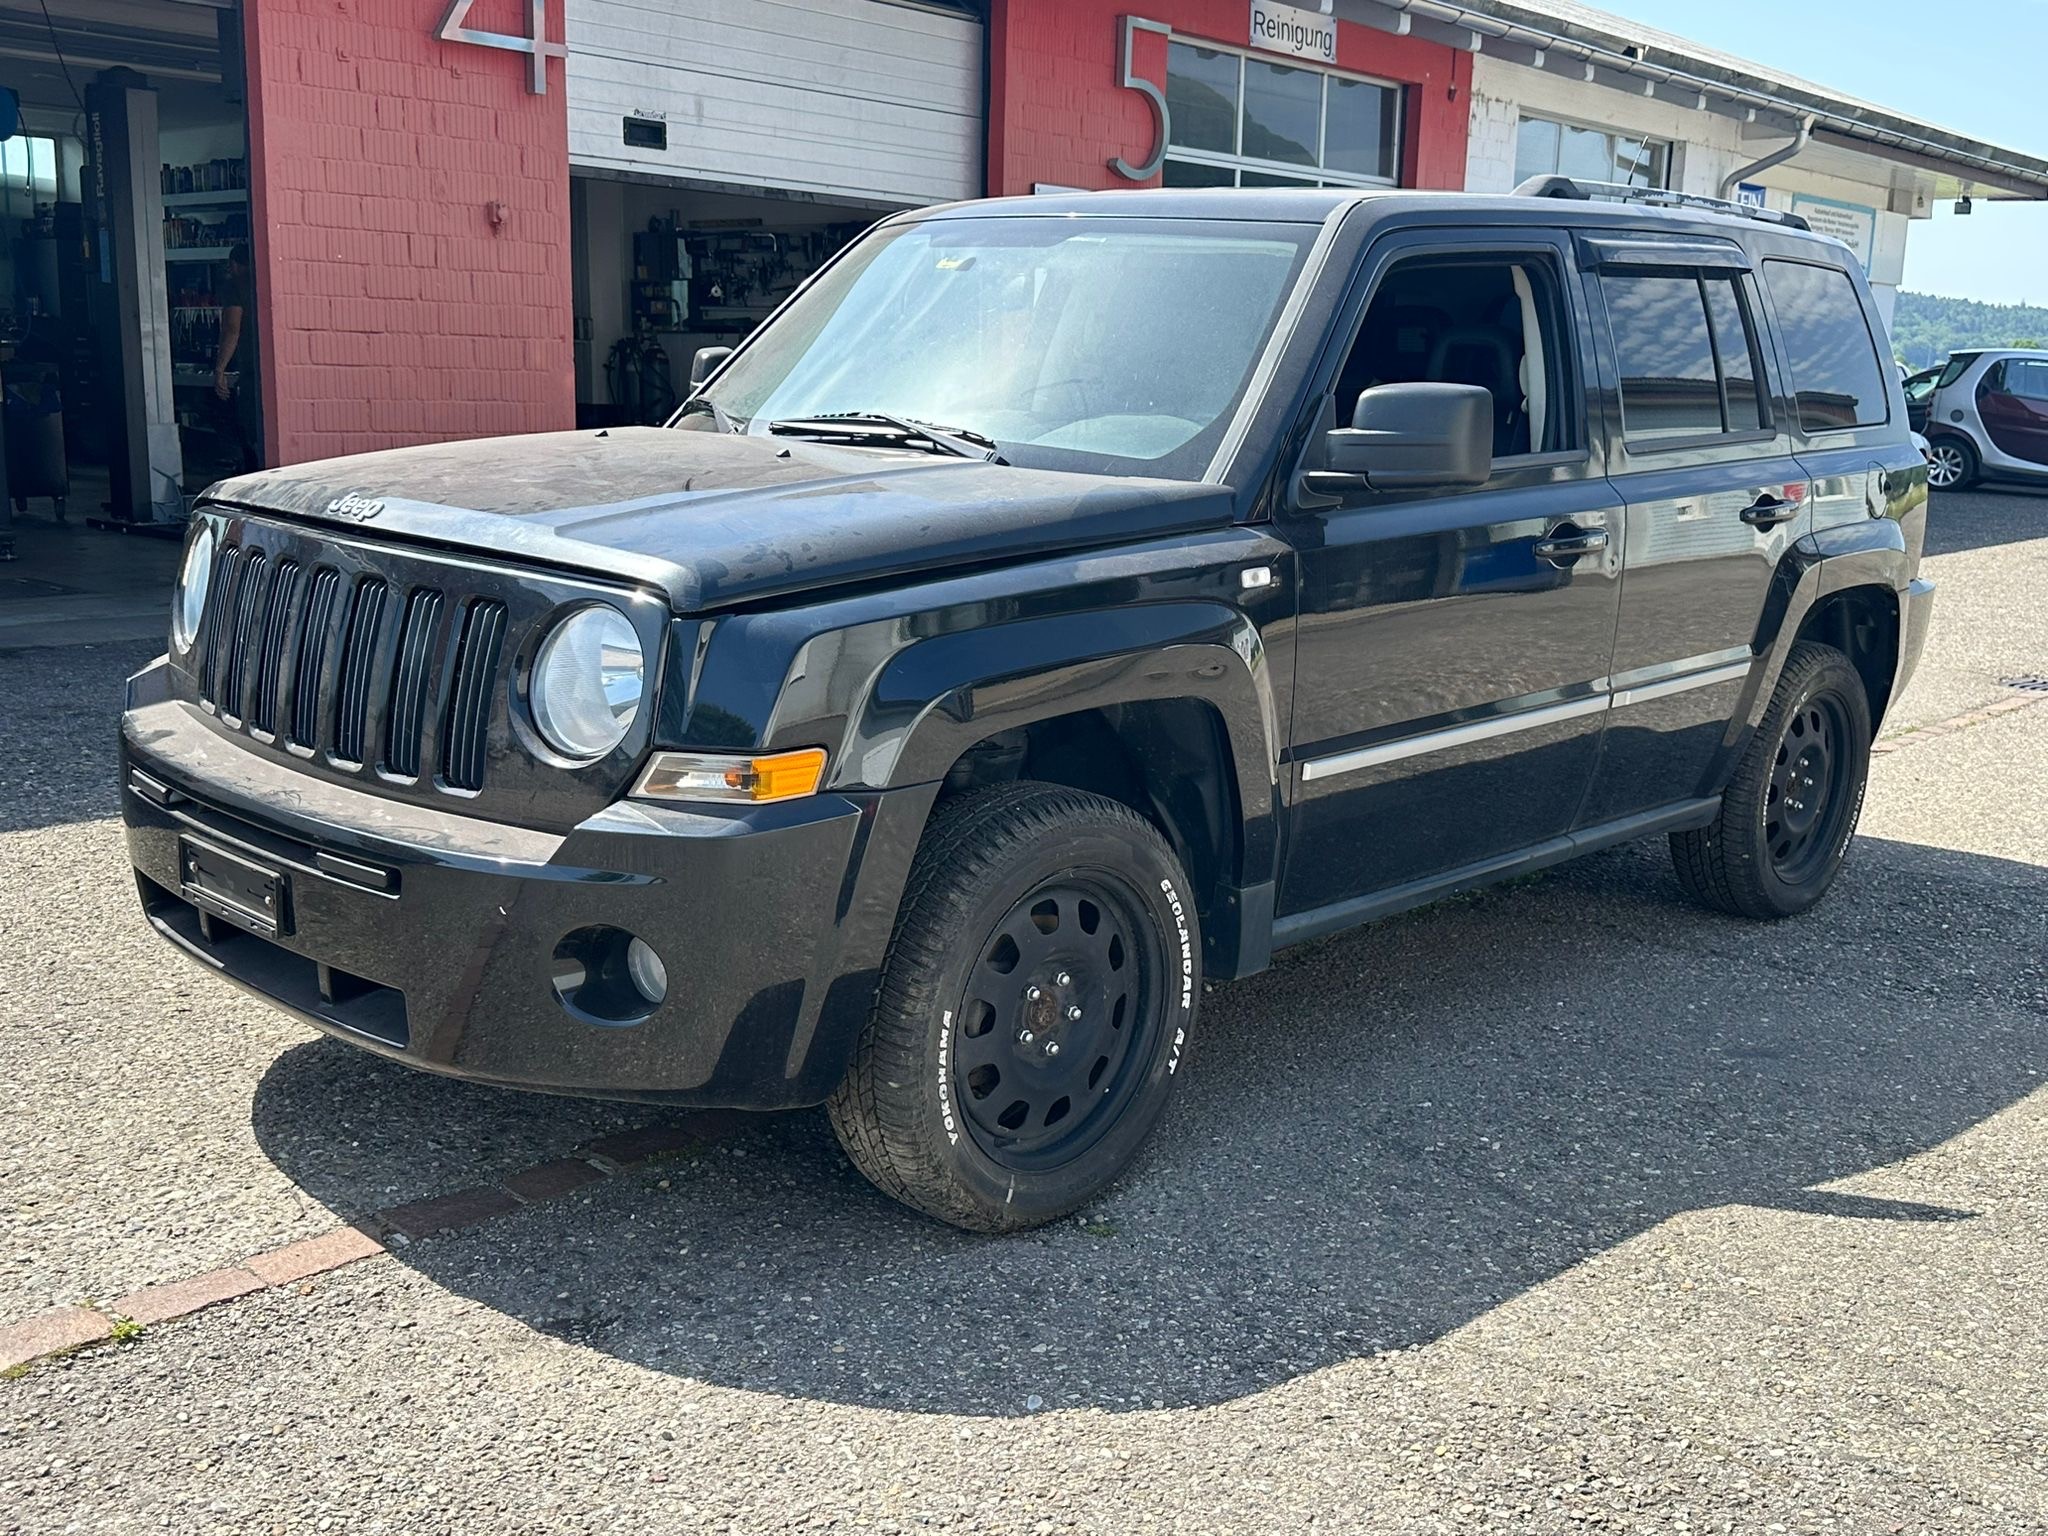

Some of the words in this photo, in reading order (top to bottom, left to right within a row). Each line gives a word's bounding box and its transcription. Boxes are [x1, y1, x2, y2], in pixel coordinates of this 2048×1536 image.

[1253, 9, 1333, 58] Reinigung
[1108, 14, 1172, 181] 5
[327, 491, 385, 522] Jeep
[1160, 878, 1192, 1010] GEOLANDAR
[938, 1009, 959, 1146] YOKOHAMA
[1168, 1026, 1186, 1076] A/T
